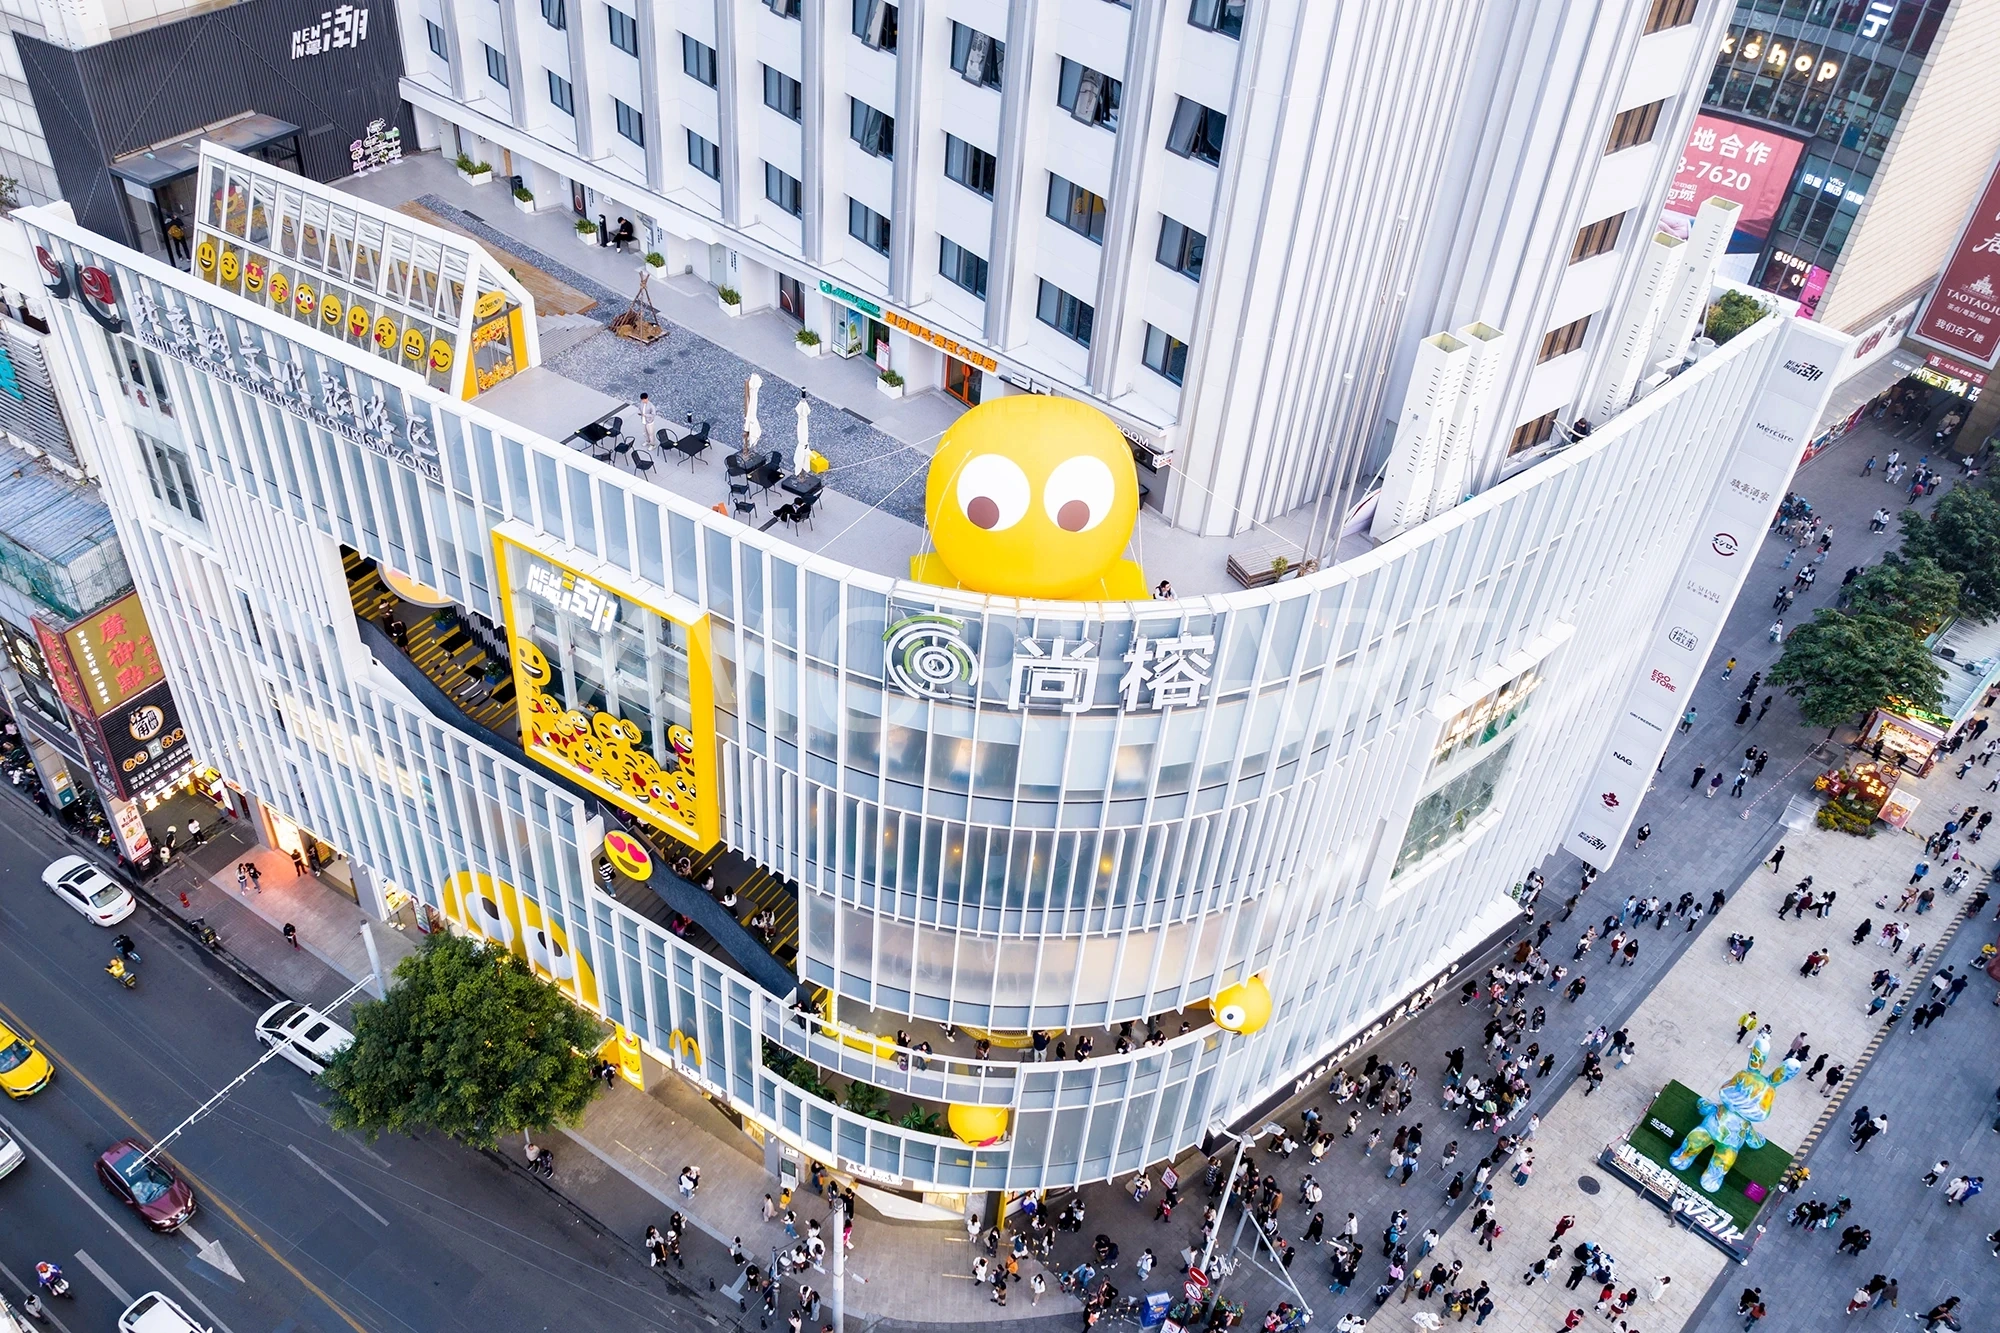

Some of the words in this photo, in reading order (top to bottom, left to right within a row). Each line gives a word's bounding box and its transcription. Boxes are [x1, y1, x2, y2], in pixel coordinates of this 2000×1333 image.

[292, 25, 321, 44] NEW
[1690, 126, 1772, 166] 地合作
[1774, 251, 1812, 274] SUSHI
[1935, 317, 1985, 345] 我们在7楼
[140, 331, 193, 363] BEIJING
[193, 354, 235, 383] ROAD
[235, 372, 316, 423] CULTURAL
[314, 409, 395, 458] TOURISM
[394, 447, 442, 481] ZONE
[1756, 422, 1795, 444] Mercure
[1711, 536, 1739, 552] スシロー
[527, 563, 562, 591] NEW
[1009, 631, 1216, 713] 尚榕
[1650, 674, 1677, 693] STORE
[1652, 669, 1671, 683] EGO
[1613, 751, 1633, 766] NAG
[1294, 1022, 1384, 1095] Mercure
